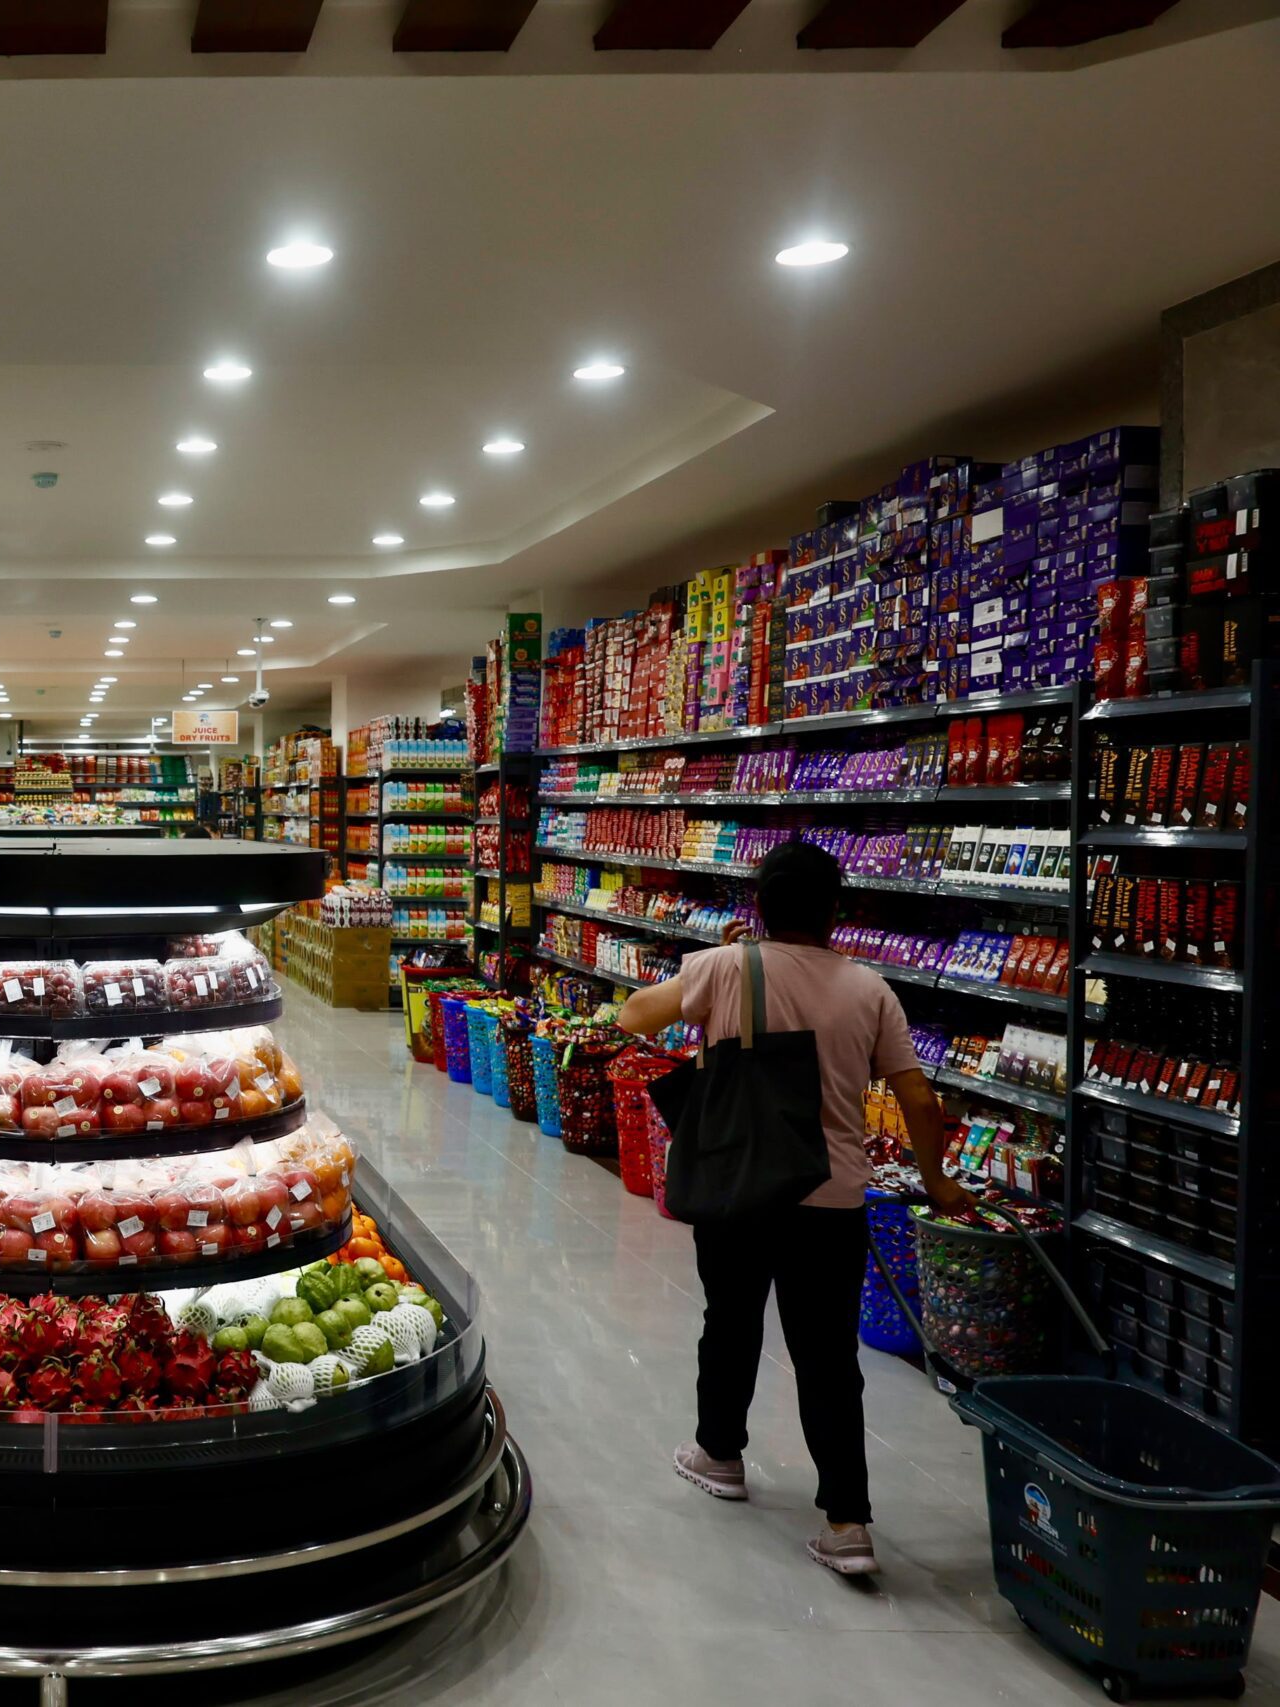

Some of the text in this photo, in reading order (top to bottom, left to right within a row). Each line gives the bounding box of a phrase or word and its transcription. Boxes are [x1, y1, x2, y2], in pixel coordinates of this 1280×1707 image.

[1134, 749, 1148, 789] Amul
[1184, 752, 1201, 790] DARK
[1121, 878, 1134, 918] Amul
